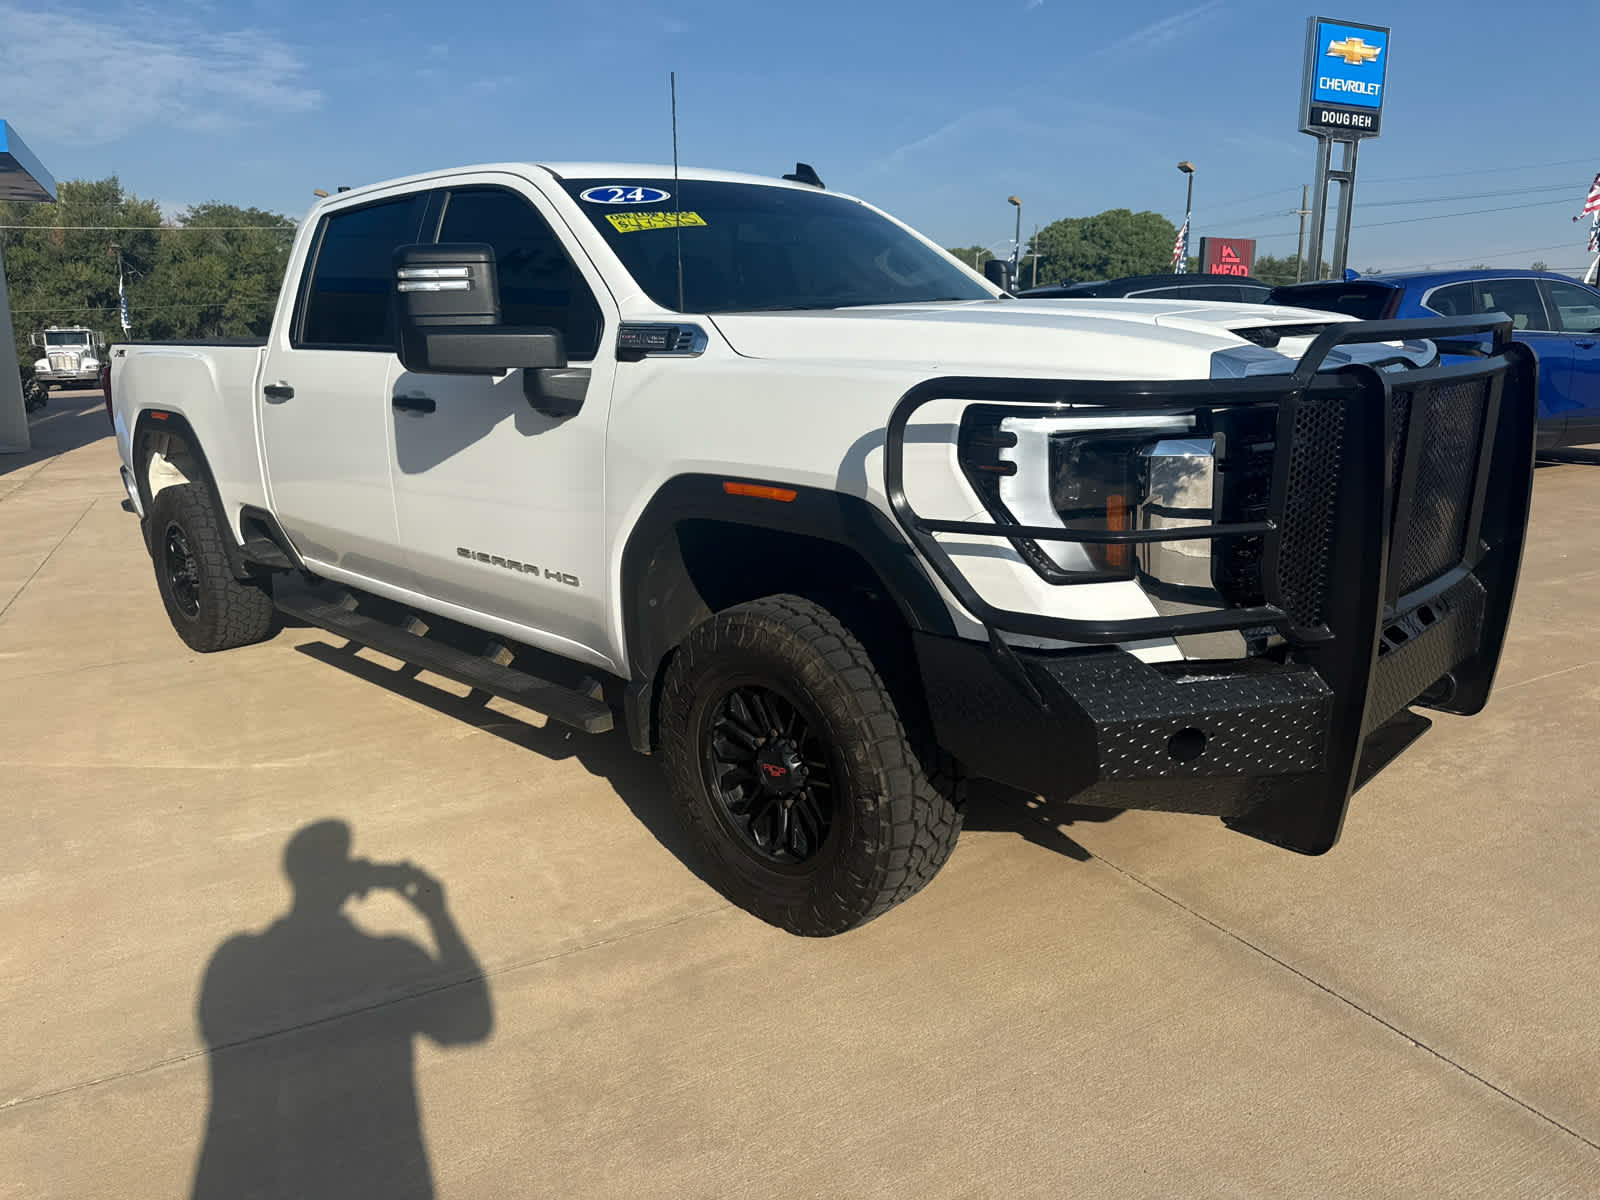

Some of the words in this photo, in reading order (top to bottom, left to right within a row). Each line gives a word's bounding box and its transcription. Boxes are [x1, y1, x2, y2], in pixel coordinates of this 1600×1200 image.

[1320, 77, 1381, 96] CHEVROLET
[1321, 111, 1350, 125] DOUG
[1351, 114, 1372, 128] REH
[607, 187, 645, 202] 24
[1211, 263, 1249, 277] MEAD
[456, 547, 540, 577] SIERRA
[544, 568, 580, 587] HD
